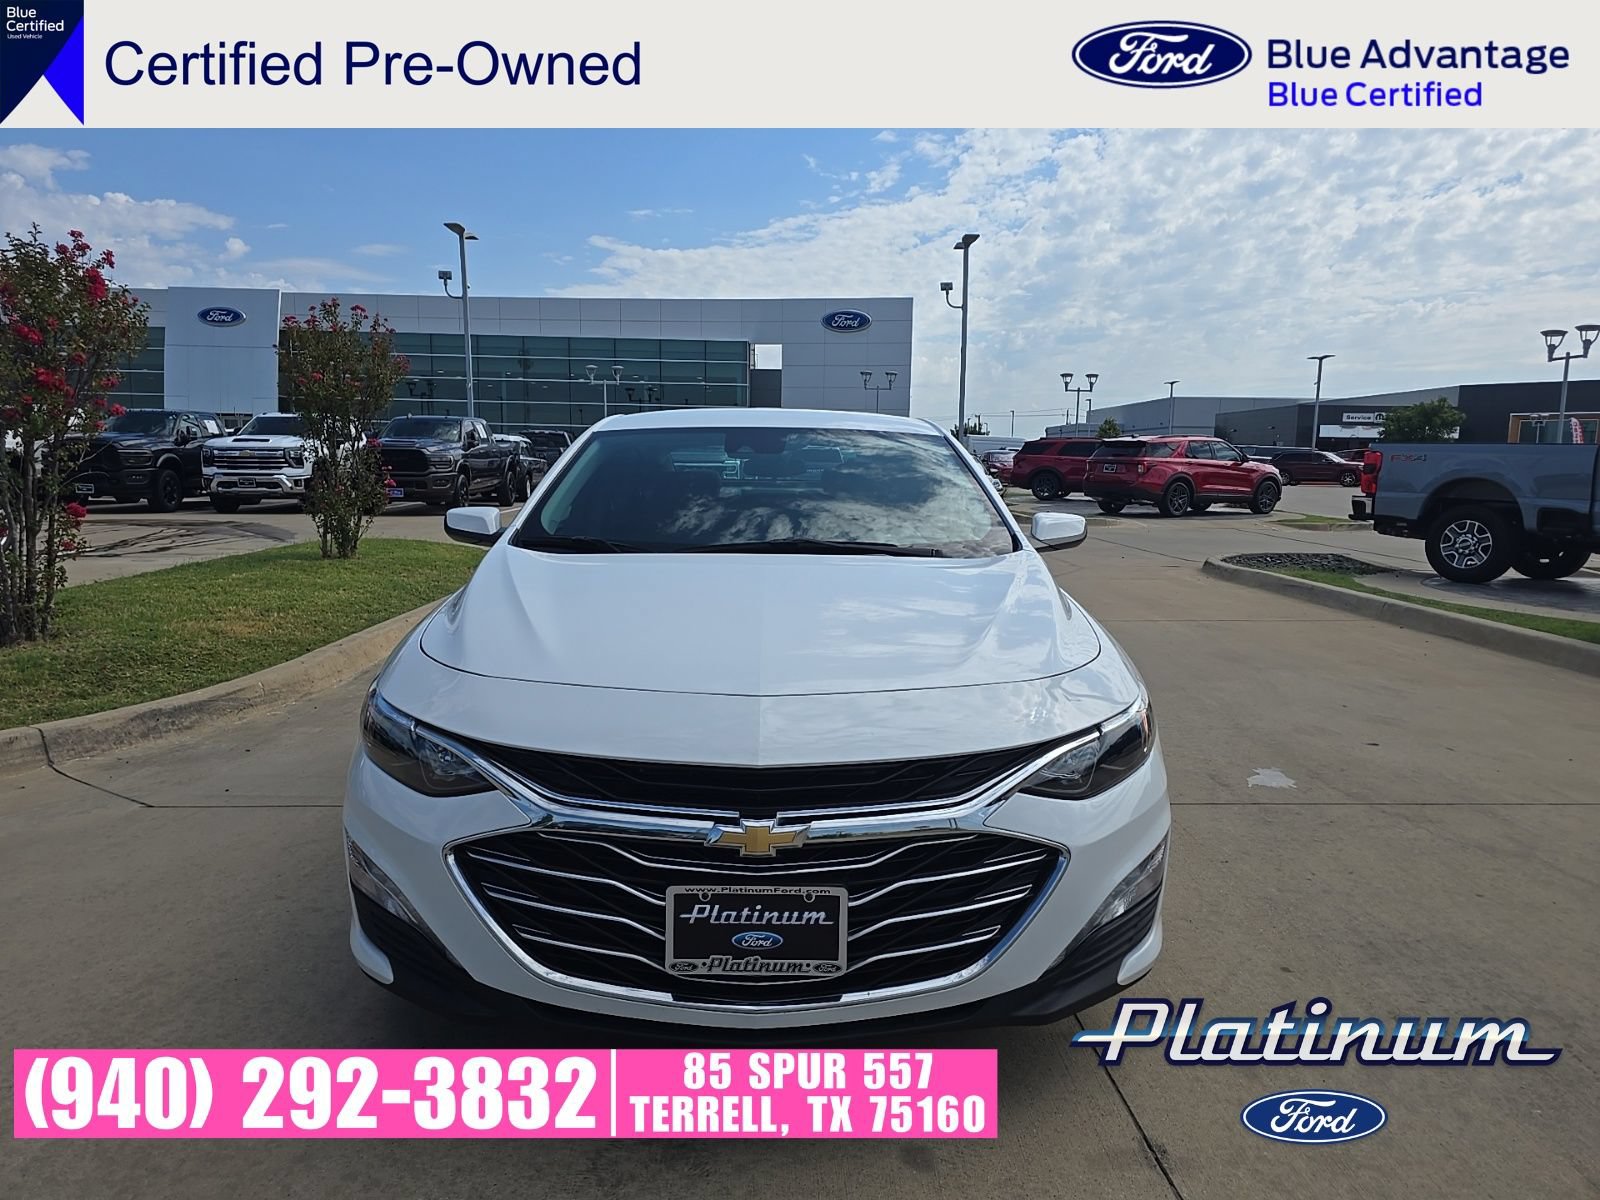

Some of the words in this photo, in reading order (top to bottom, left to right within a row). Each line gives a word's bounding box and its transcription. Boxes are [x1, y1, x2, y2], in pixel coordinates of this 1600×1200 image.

[206, 310, 234, 322] Ford
[831, 314, 861, 327] Ford
[685, 886, 831, 895] www.PlatinumFord.com
[680, 904, 834, 925] Platinum
[741, 934, 774, 947] Ford
[674, 962, 694, 971] Ford
[707, 956, 810, 973] Platinum
[818, 963, 838, 973] Ford
